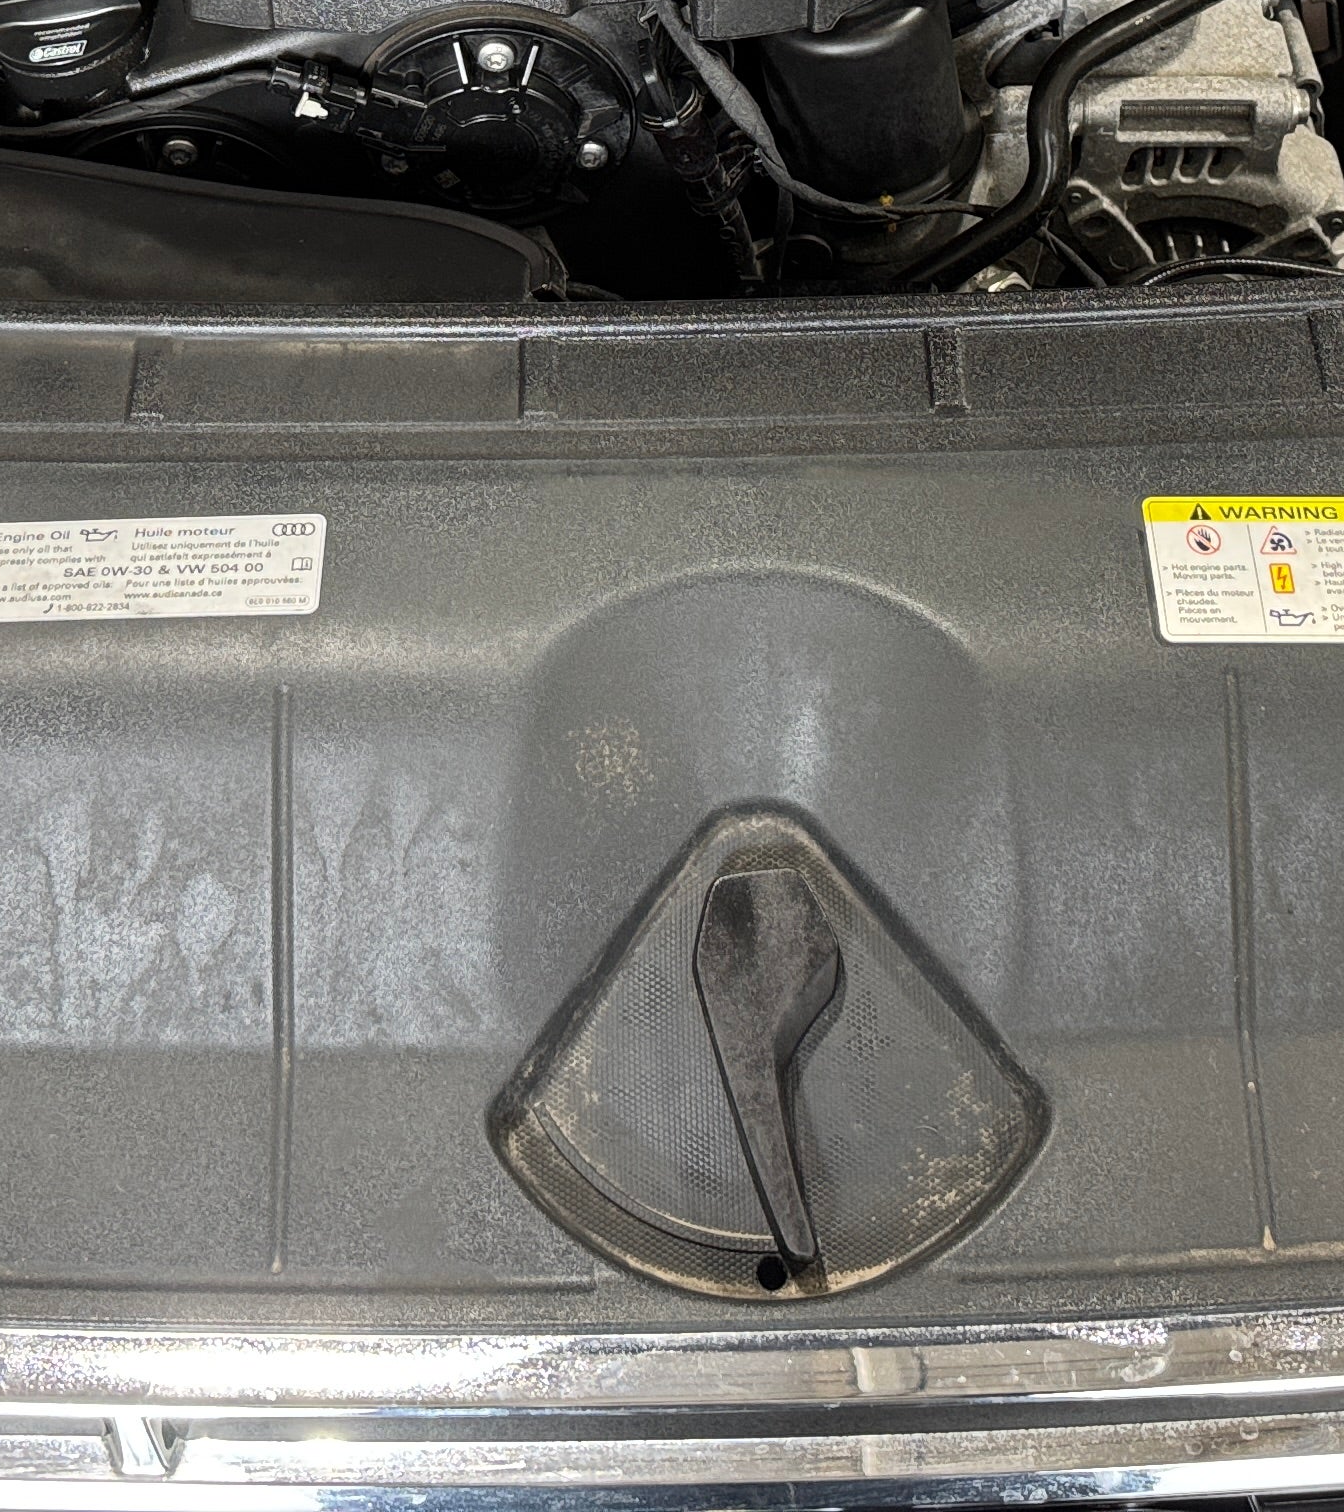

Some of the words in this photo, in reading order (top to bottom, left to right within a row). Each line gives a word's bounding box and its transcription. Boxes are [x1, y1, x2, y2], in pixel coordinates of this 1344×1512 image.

[43, 42, 82, 58] Castrol
[1218, 505, 1339, 520] WARNING
[50, 530, 71, 540] Oil
[134, 527, 173, 538] Huile
[177, 526, 236, 536] moteur
[12, 545, 35, 555] only
[37, 544, 51, 553] oil
[52, 544, 73, 553] that
[131, 540, 168, 551] Utilisez
[170, 539, 231, 551] uniquement
[233, 539, 246, 548] de
[1325, 545, 1344, 553] tout
[37, 555, 82, 566] complies
[84, 554, 106, 563] with
[130, 552, 147, 562] qui
[149, 551, 189, 561] satisfait
[192, 550, 263, 561] expressément
[63, 566, 97, 578] SAE
[100, 564, 153, 578] 0W-30
[158, 564, 171, 575] &
[176, 563, 206, 574] VW
[210, 562, 239, 574] 504
[244, 562, 264, 573] 00
[1171, 563, 1188, 571] Hot
[1190, 563, 1221, 573] engine
[1320, 561, 1342, 570] High
[1172, 571, 1208, 581] Moving
[1, 584, 8, 592] a
[10, 582, 27, 592] list
[29, 582, 39, 592] of
[41, 580, 90, 592] approved
[125, 578, 150, 588] Pour
[152, 578, 171, 587] une
[174, 577, 195, 587] liste
[123, 589, 223, 600] www.audicanada.ca
[1206, 588, 1219, 597] du
[56, 601, 130, 613] 1-800-822-2834
